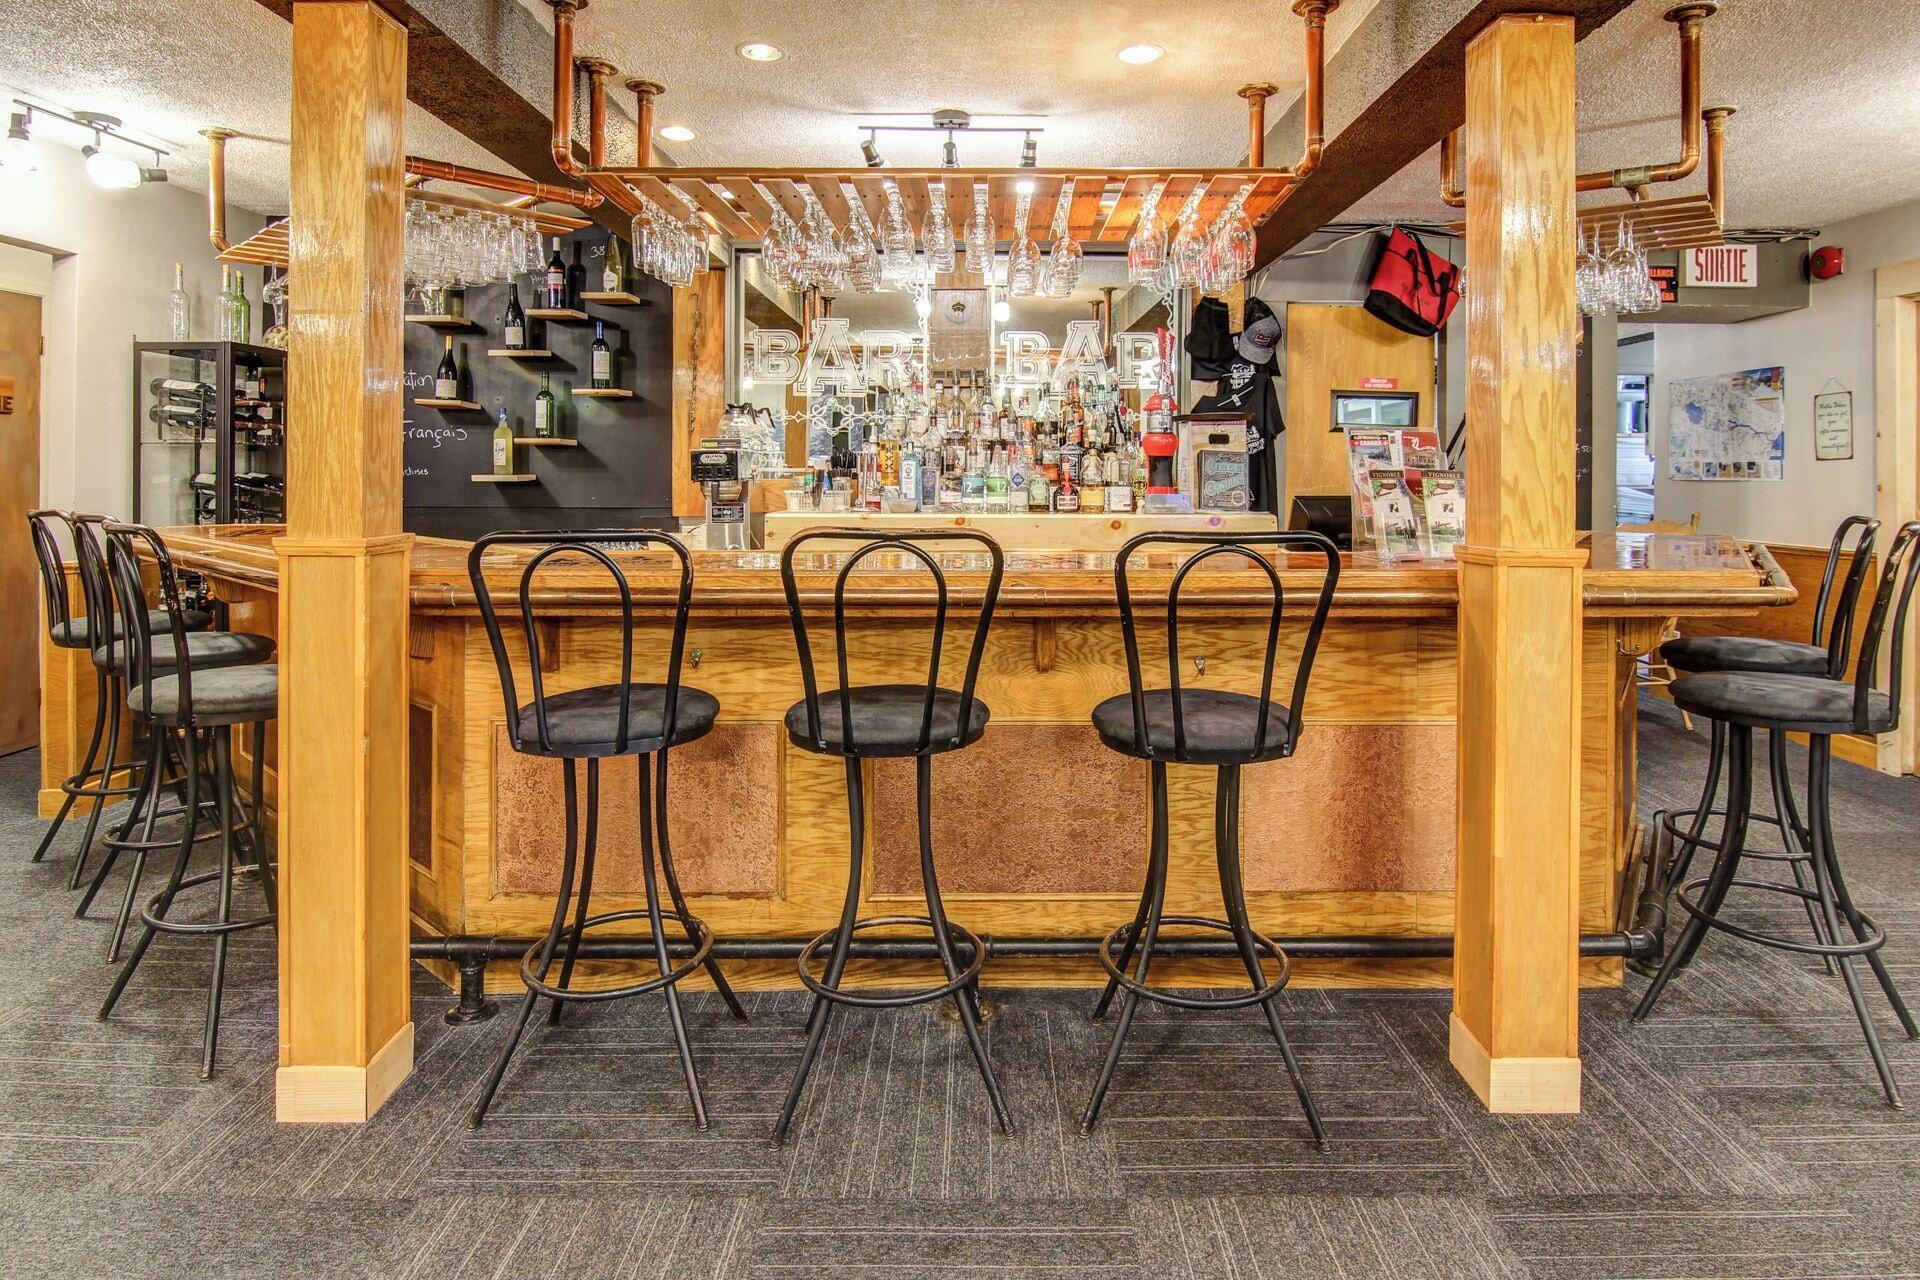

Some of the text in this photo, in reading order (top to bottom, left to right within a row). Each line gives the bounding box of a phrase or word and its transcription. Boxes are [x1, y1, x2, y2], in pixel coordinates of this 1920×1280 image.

[1694, 247, 1748, 283] SORTIE
[749, 317, 914, 397] BAR
[1000, 320, 1164, 396] BAR
[403, 369, 434, 391] ation
[1427, 471, 1461, 479] VIGNOBLE
[962, 481, 973, 493] 12
[996, 481, 1007, 493] 12
